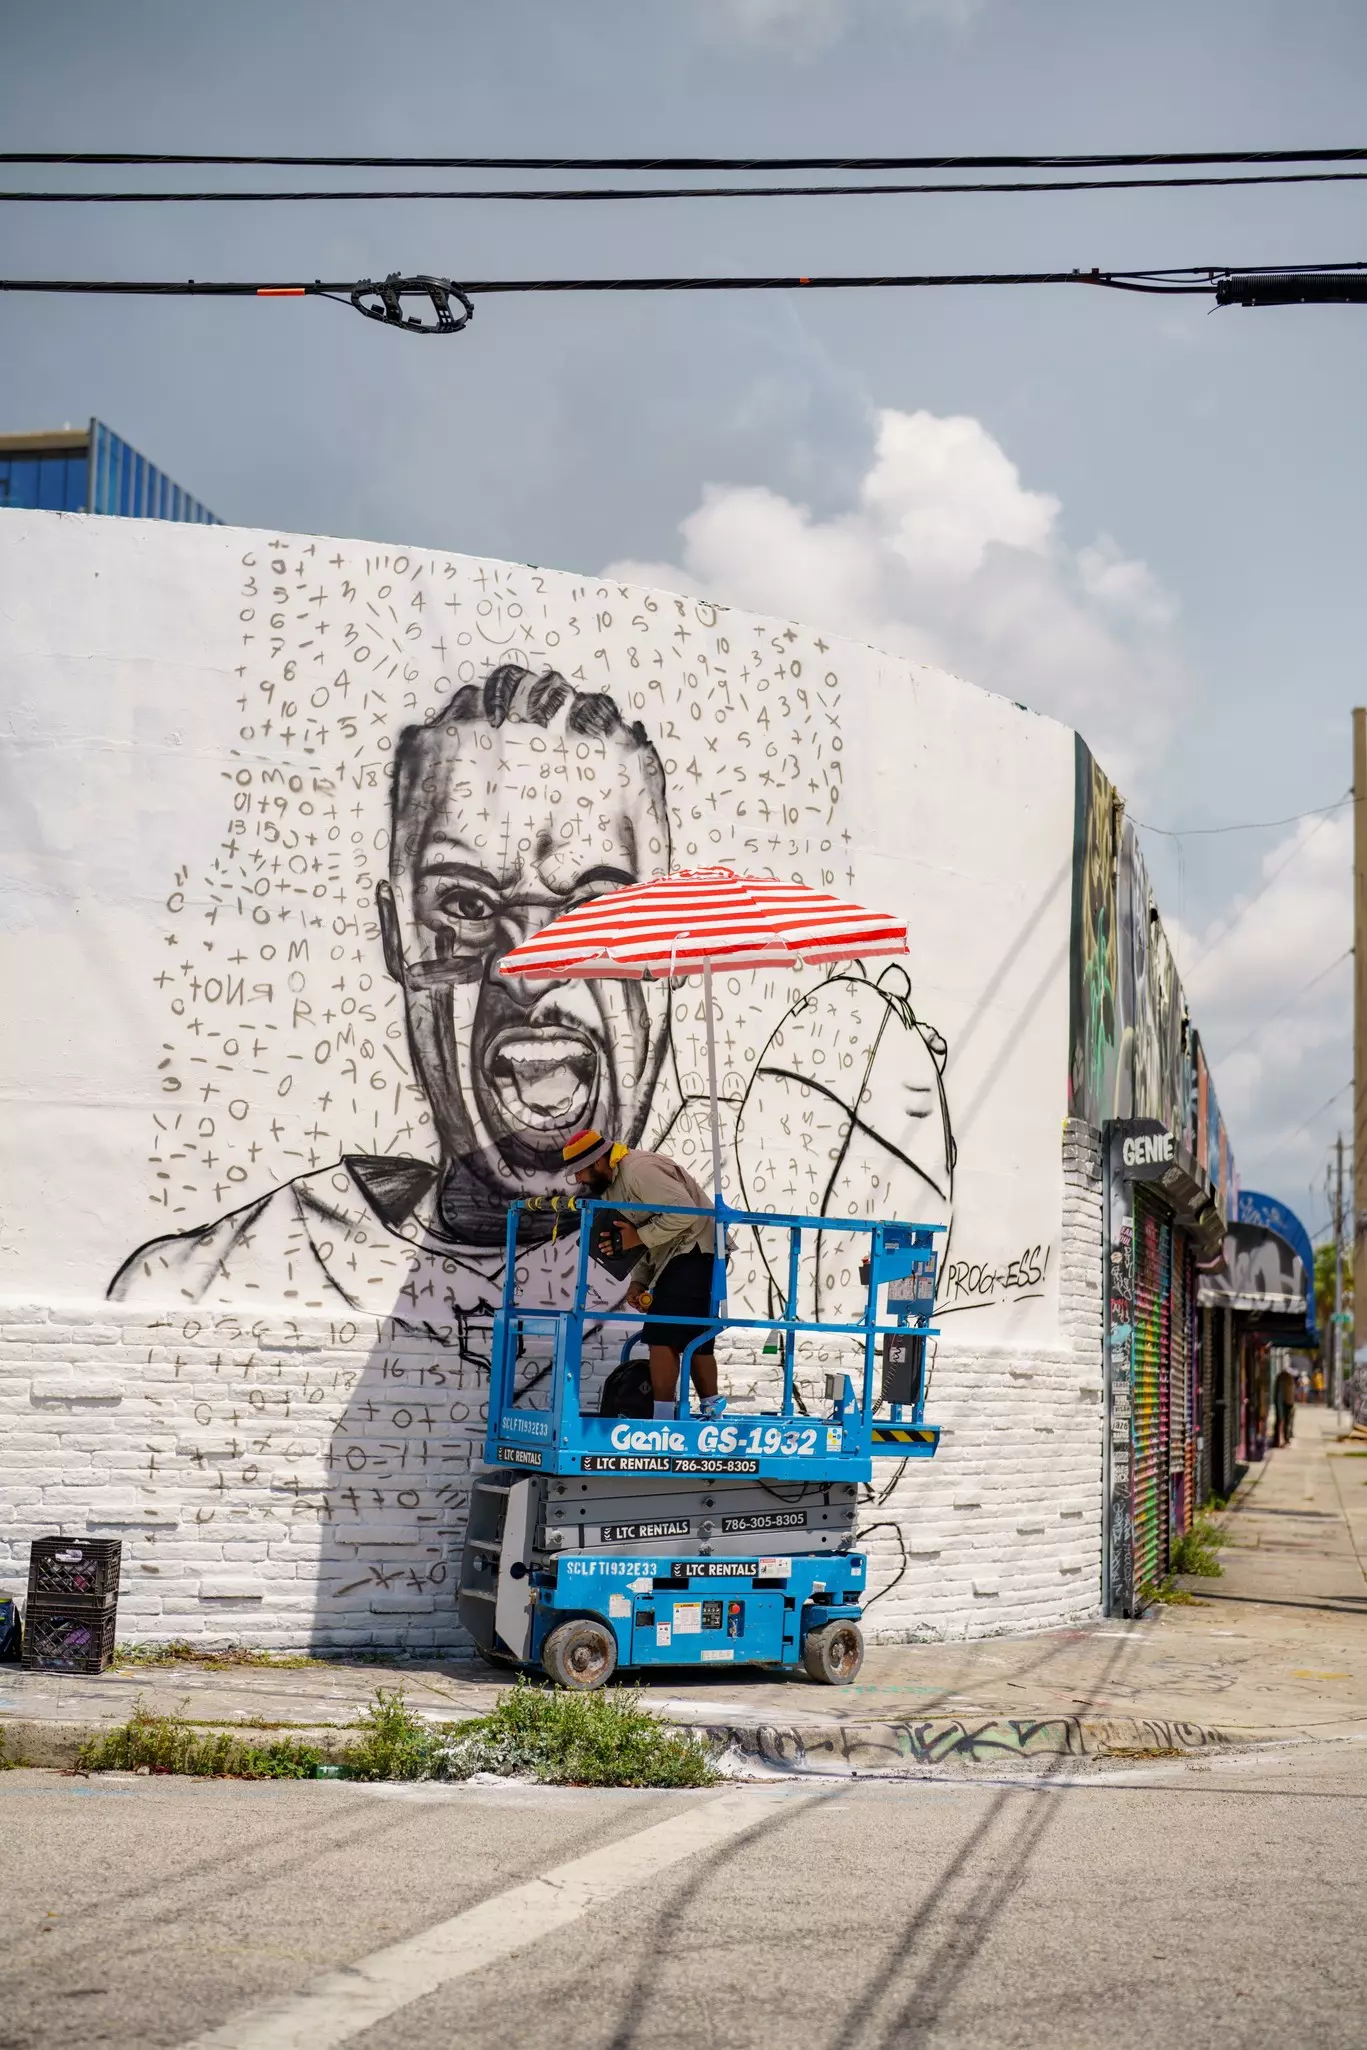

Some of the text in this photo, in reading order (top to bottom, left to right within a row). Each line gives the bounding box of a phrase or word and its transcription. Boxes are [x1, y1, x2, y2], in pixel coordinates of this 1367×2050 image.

[1122, 1132, 1175, 1166] GENIE
[611, 1424, 686, 1451] Genie
[697, 1425, 817, 1455] GS-1932
[504, 1448, 542, 1465] LTC RENTALS
[597, 1457, 669, 1471] LTC RENTALS
[675, 1460, 757, 1473] 786-305-8305
[616, 1521, 689, 1539] LTC RENTALS
[725, 1513, 805, 1532] 786-305-8305
[686, 1563, 705, 1576] LTC
[708, 1563, 757, 1576] RENTALS
